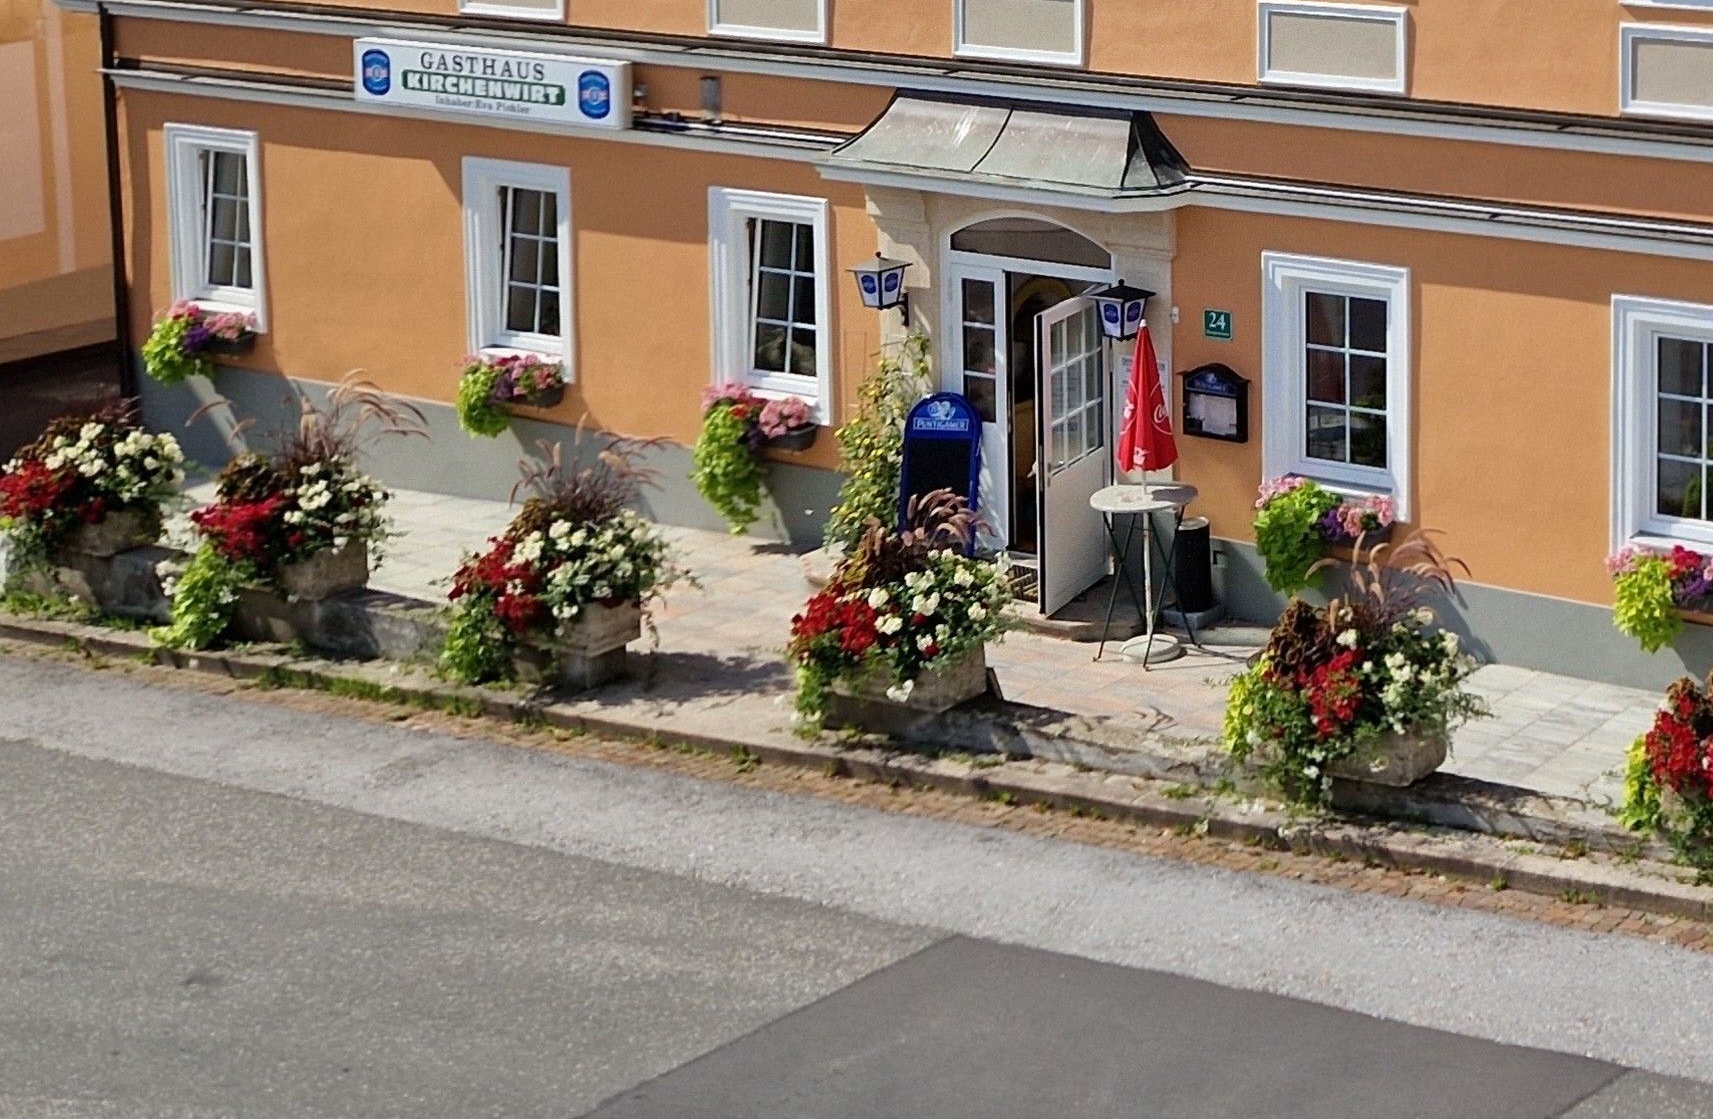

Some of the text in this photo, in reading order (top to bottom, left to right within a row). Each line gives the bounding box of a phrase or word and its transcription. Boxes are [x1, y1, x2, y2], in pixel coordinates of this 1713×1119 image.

[420, 51, 545, 81] GASTHAUS
[406, 71, 560, 104] KIRCHENWIRT
[1208, 311, 1226, 331] 24
